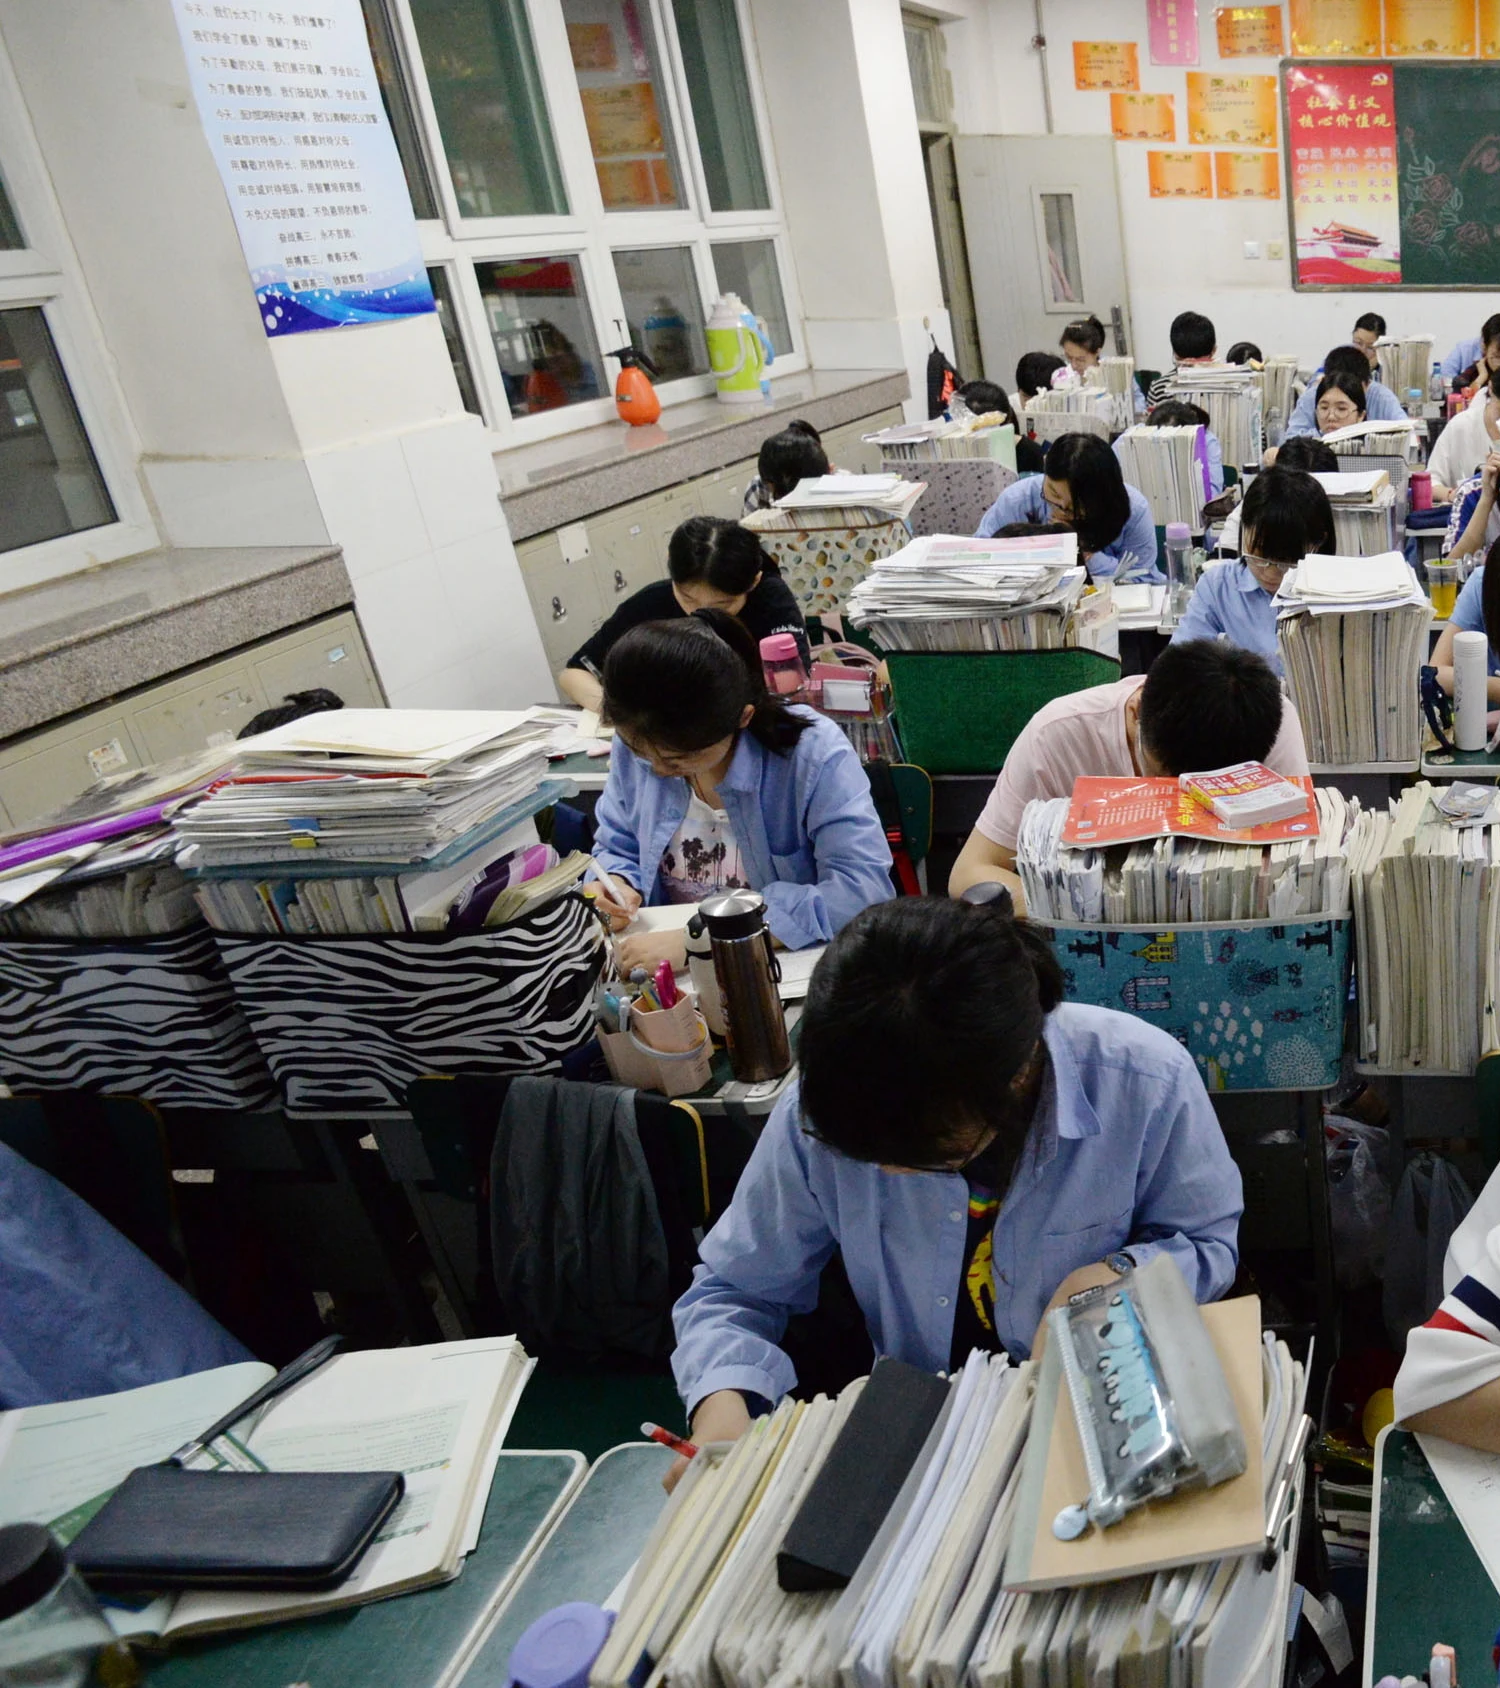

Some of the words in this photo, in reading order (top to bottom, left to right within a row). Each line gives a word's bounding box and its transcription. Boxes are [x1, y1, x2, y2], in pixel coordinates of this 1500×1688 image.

[1306, 94, 1381, 111] 社会主义
[1297, 112, 1392, 129] 核心价值观
